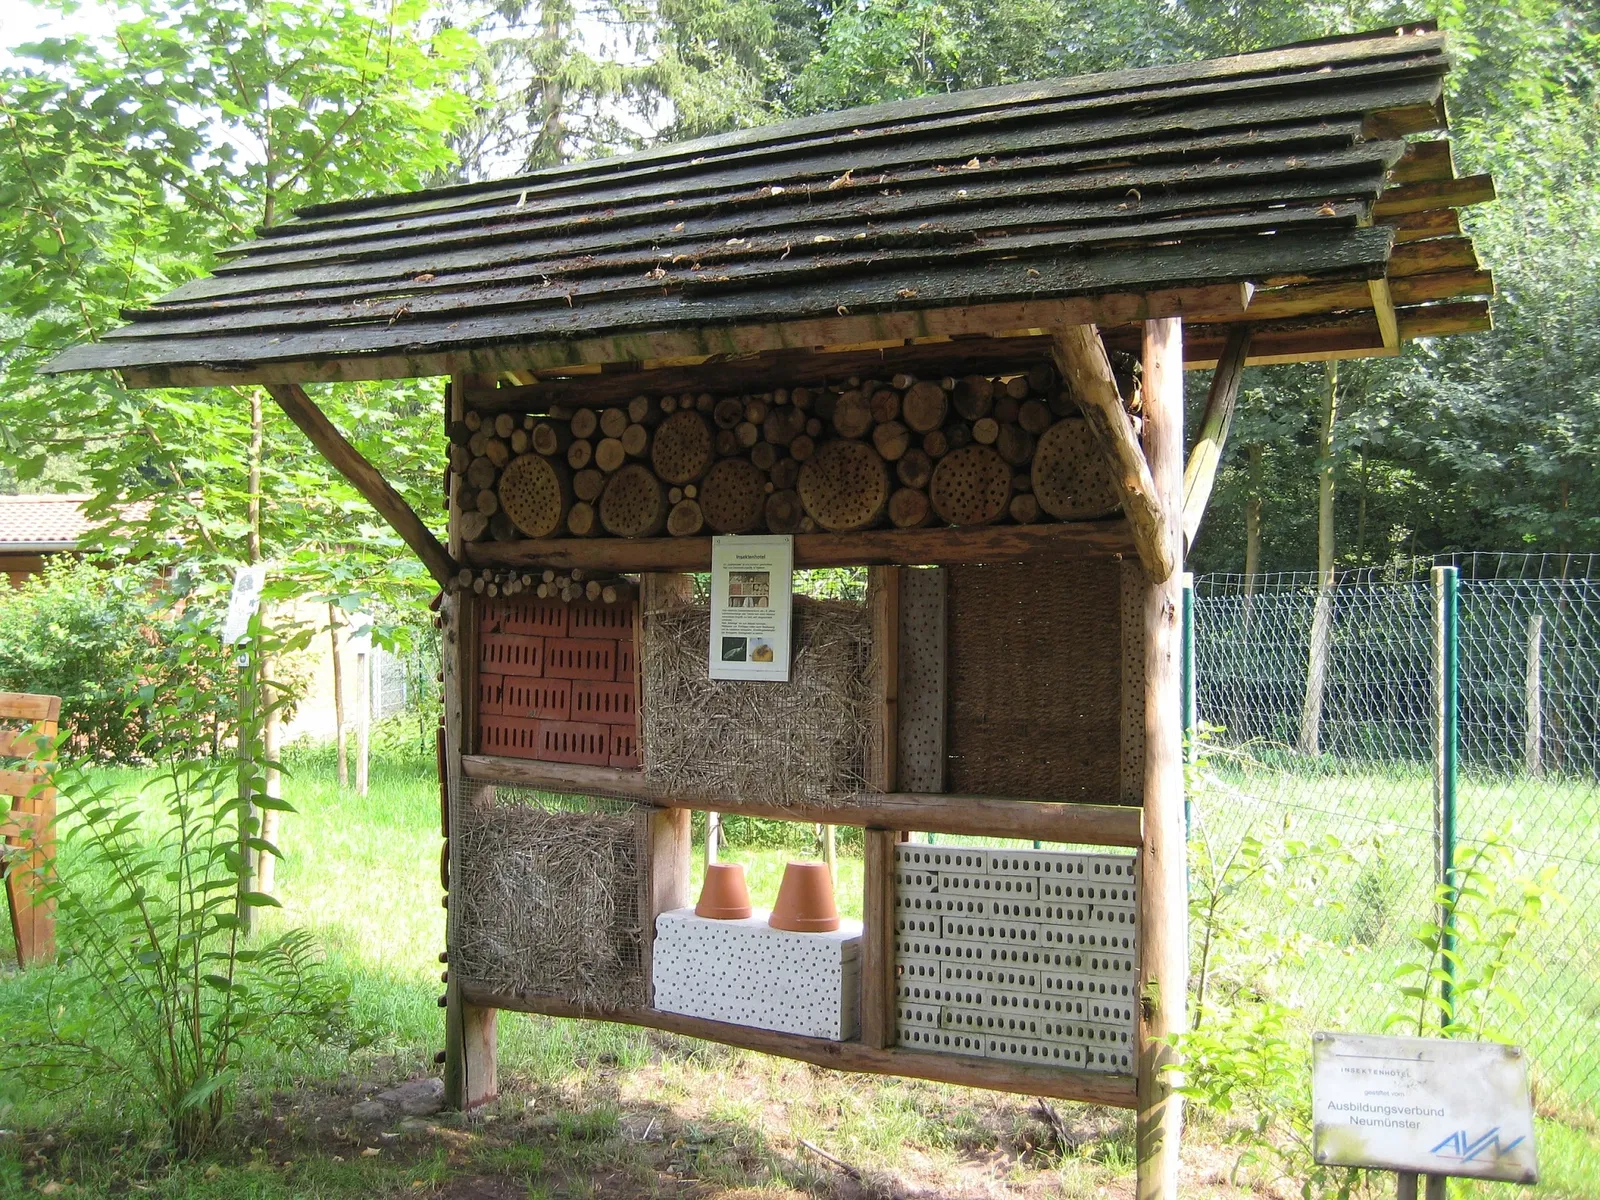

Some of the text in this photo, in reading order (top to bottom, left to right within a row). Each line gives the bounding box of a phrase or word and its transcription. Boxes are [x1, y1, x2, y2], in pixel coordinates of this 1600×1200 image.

[1340, 1067, 1412, 1078] INSEKTENHOTEL
[1327, 1100, 1445, 1117] Ausbildungsverbund
[1349, 1116, 1421, 1129] Neumünster
